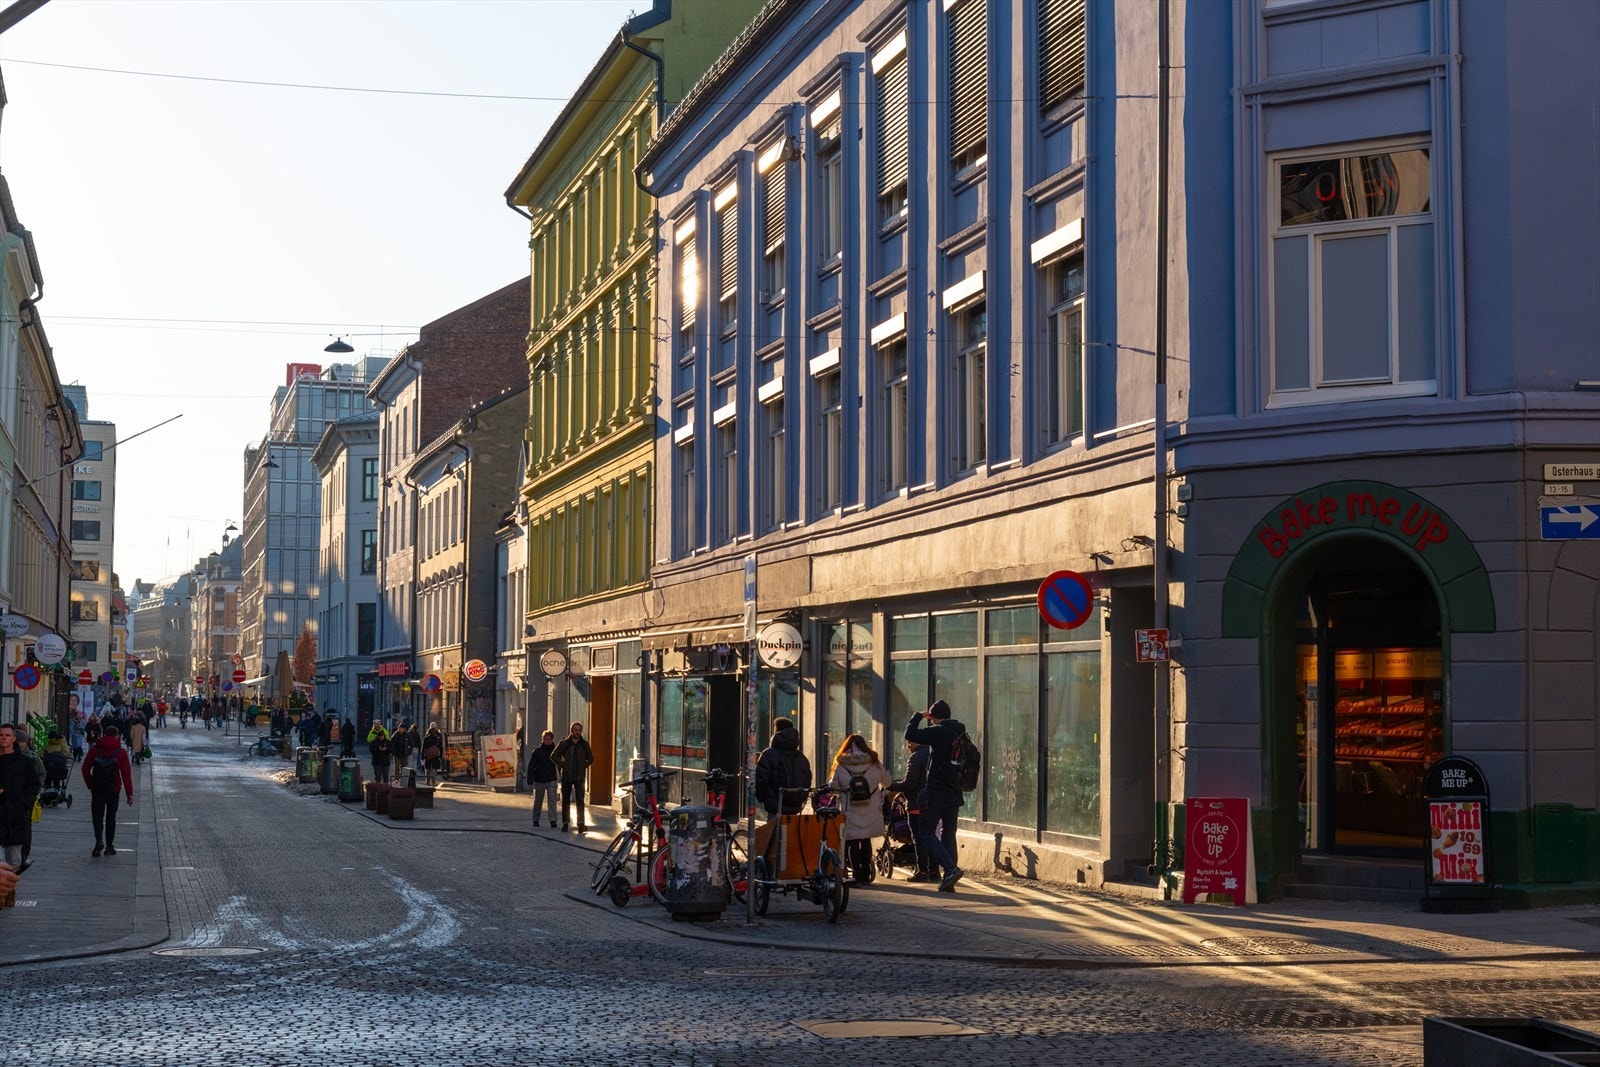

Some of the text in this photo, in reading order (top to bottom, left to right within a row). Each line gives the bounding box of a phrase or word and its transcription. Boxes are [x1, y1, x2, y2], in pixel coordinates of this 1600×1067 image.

[1552, 466, 1594, 476] Osterhaus
[1346, 493, 1401, 526] me
[760, 638, 801, 651] Duckpin
[543, 659, 566, 667] oche
[1441, 769, 1466, 779] BAKE
[1441, 779, 1468, 788] ME UP
[1430, 801, 1481, 830] Mini
[1203, 822, 1229, 834] Bake
[1207, 834, 1225, 844] me
[1459, 831, 1475, 843] 10
[1463, 843, 1481, 855] 69
[1439, 852, 1478, 880] Mix
